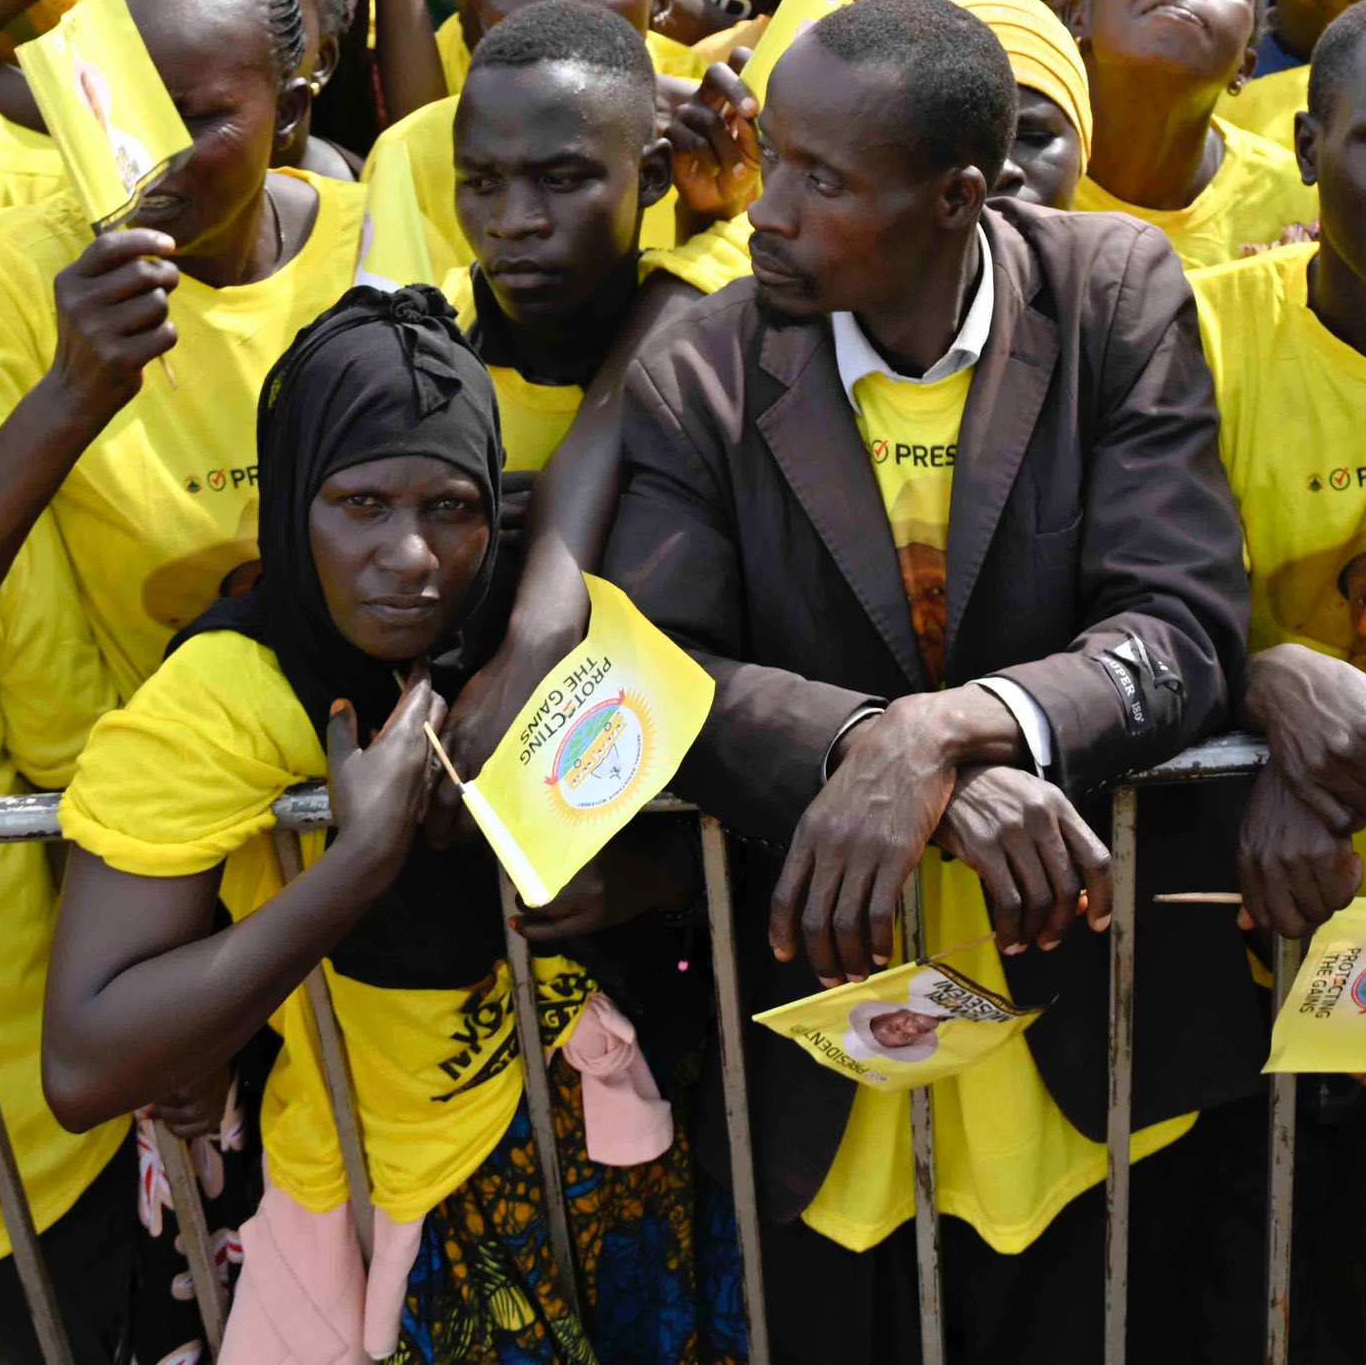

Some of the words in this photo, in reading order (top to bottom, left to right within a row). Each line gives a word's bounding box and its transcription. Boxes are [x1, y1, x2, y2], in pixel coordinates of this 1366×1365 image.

[563, 657, 598, 692] THE
[520, 656, 612, 766] PROTECTING
[520, 690, 564, 744] GAINS
[1315, 947, 1362, 1019] PROTECTING
[1316, 954, 1339, 976] THE
[1299, 979, 1327, 1014] GAINS
[803, 1028, 870, 1077] PRESIDENT
